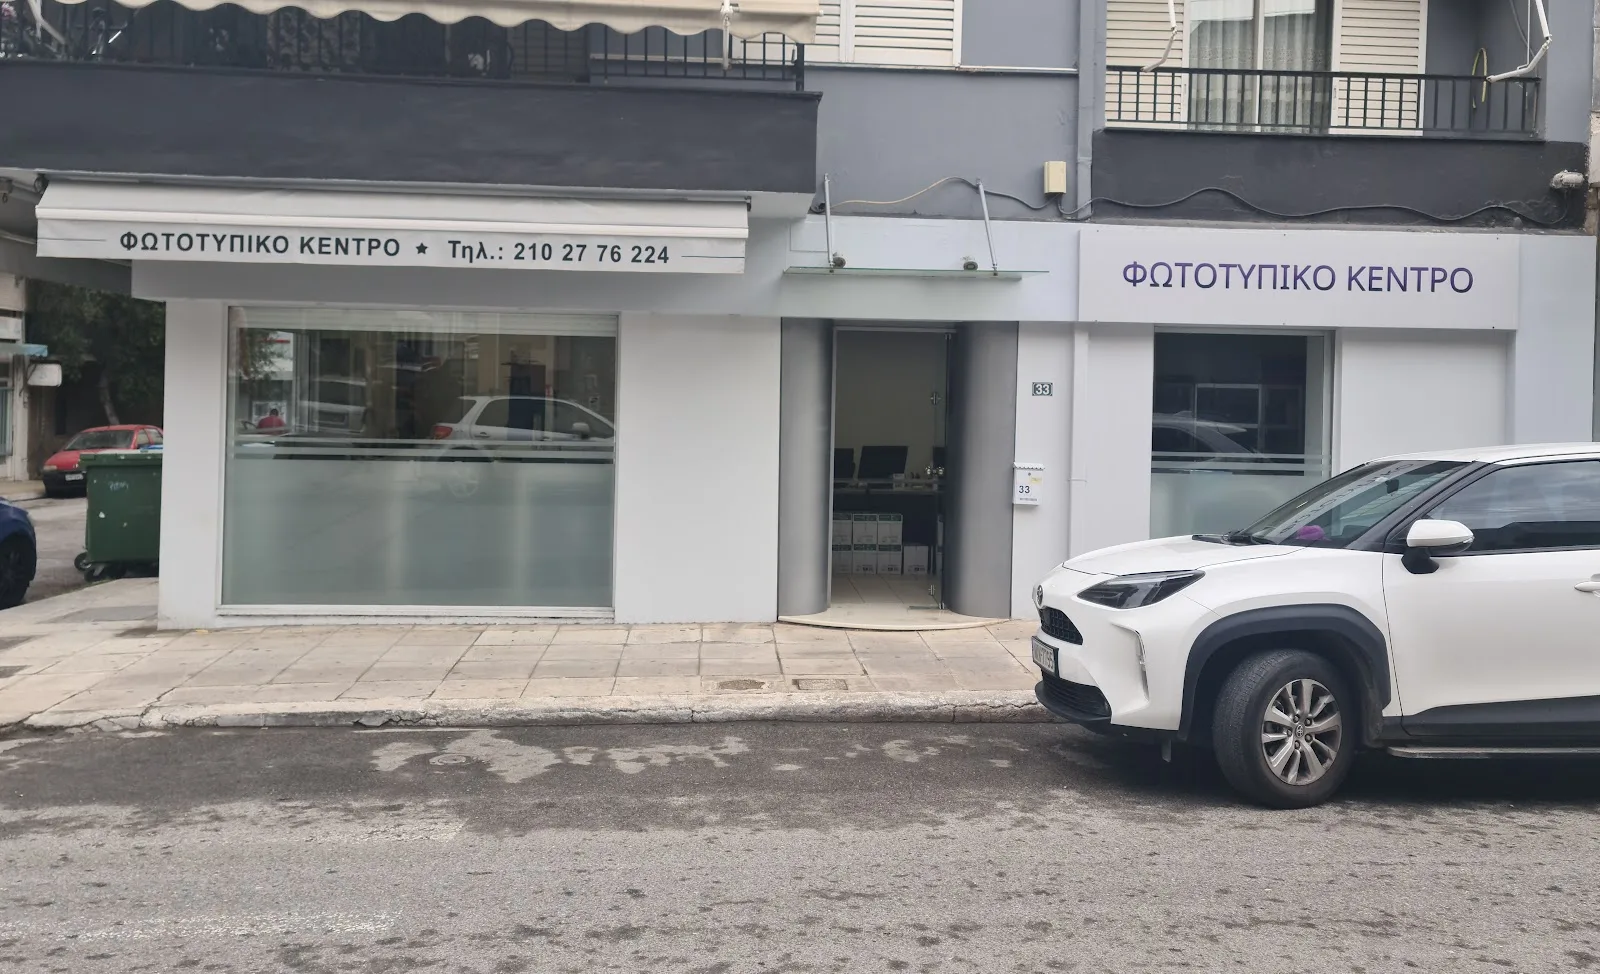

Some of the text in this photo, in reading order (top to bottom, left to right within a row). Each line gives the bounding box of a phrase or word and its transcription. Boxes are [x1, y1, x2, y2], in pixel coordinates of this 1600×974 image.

[119, 231, 400, 257] ΦΩΤΟΤΥΠΙΚΟ ΚΕΝΤΡΟ
[447, 240, 669, 264] Τηλ.: 210 27 76 224
[1122, 261, 1474, 294] ΦΩΤΟΤΥΠΙΚΟ ΚΕΝΤΡΟ
[1035, 383, 1050, 395] 33
[1018, 485, 1031, 494] 33
